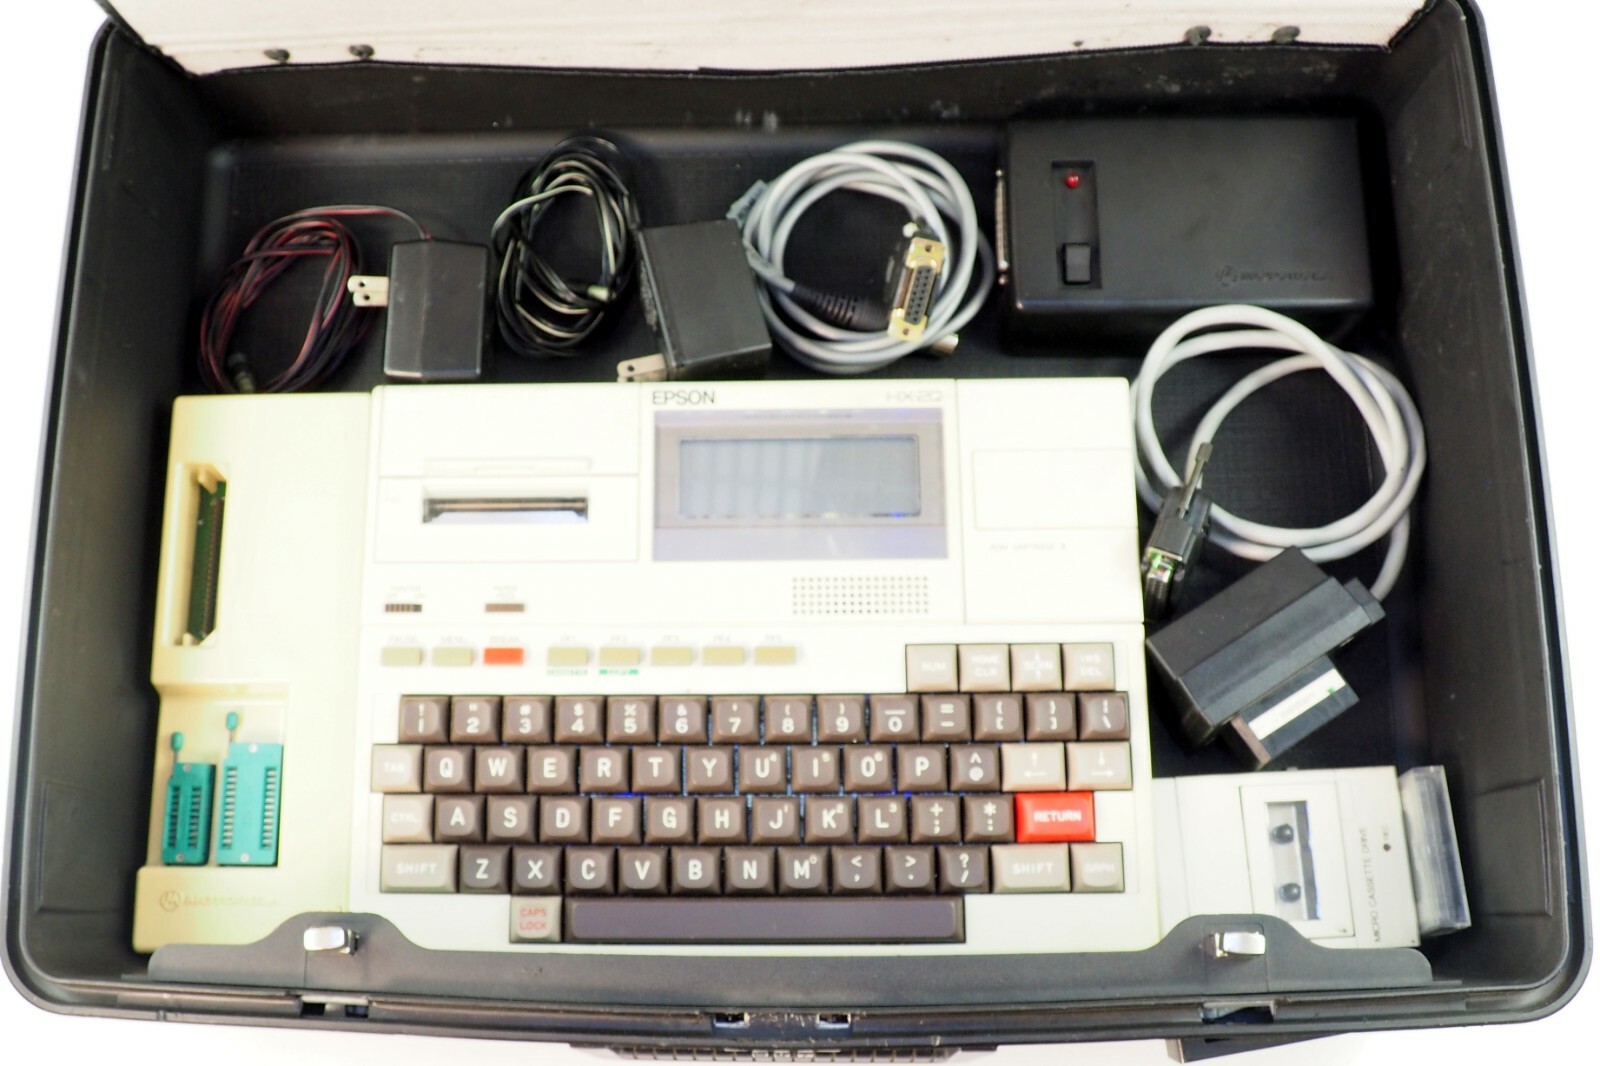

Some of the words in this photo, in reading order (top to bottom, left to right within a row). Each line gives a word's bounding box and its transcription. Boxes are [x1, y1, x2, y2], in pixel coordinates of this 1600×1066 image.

[651, 390, 716, 406] EPSON
[1080, 666, 1102, 677] DEL
[465, 717, 480, 733] 2
[519, 717, 532, 734] 3
[570, 717, 585, 733] 4
[624, 717, 637, 734] 5
[675, 717, 689, 734] 6
[728, 717, 742, 734] 7
[782, 717, 795, 734] 8
[835, 715, 849, 733] 9
[887, 715, 903, 733] 0
[439, 757, 453, 778] Q
[487, 757, 507, 777] W
[543, 757, 557, 778] E
[597, 757, 612, 778] R
[647, 756, 663, 778] T
[701, 757, 717, 778] Y
[755, 757, 770, 779] U
[915, 756, 930, 777] P
[449, 806, 465, 827] A
[503, 806, 518, 829] S
[555, 807, 571, 829] D
[608, 807, 623, 828] F
[662, 806, 677, 829] G
[714, 809, 730, 829] H
[768, 809, 783, 830] J
[821, 807, 837, 829] K
[875, 807, 890, 829] L
[1033, 810, 1082, 822] RETURN
[1359, 826, 1370, 854] DRIVE
[396, 862, 437, 875] SHIFT
[475, 857, 490, 880] Z
[527, 859, 544, 880] X
[581, 858, 596, 881] C
[634, 859, 651, 881] V
[688, 859, 703, 881] B
[742, 859, 758, 881] N
[792, 859, 810, 880] M
[958, 852, 970, 869] ?
[1012, 862, 1054, 875] SHIFT
[1363, 857, 1378, 908] CASSETTE
[519, 907, 547, 918] CAPS
[519, 919, 547, 931] LOCK
[1370, 910, 1382, 943] MICRO
